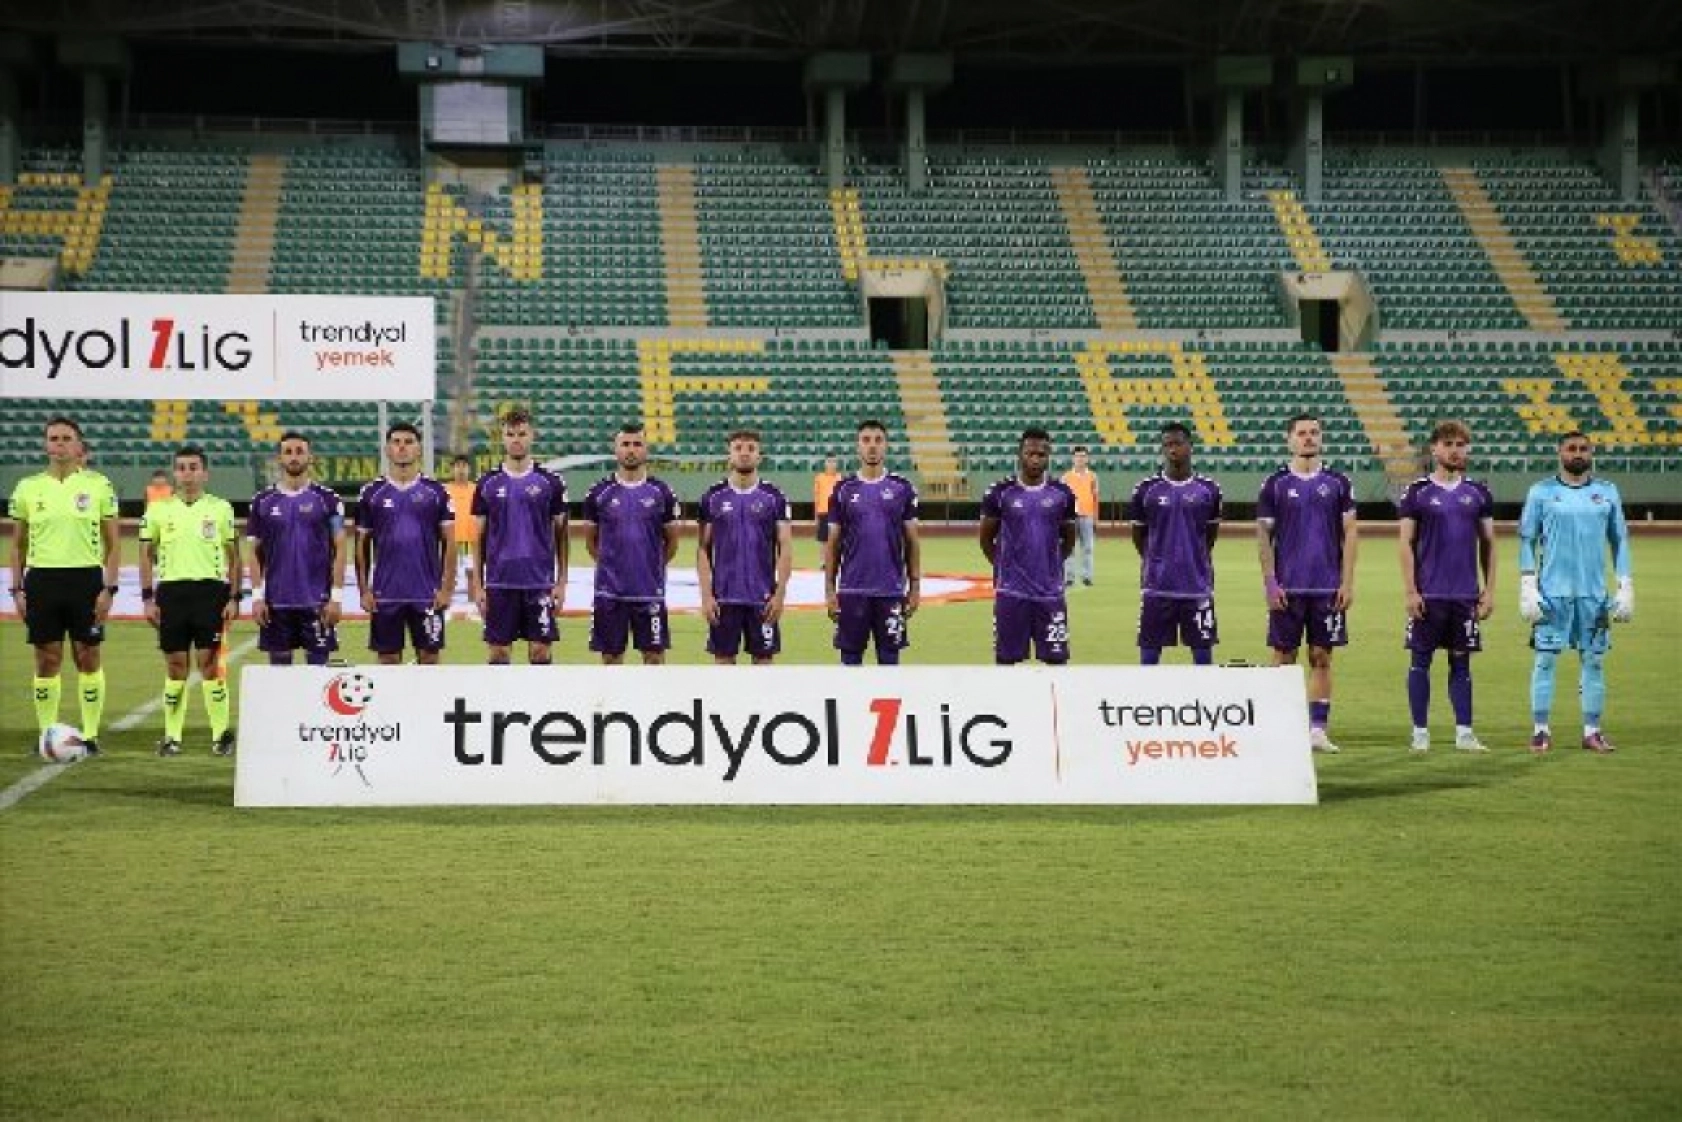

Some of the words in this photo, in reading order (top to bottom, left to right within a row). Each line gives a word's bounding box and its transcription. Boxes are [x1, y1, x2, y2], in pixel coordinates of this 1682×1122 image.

[300, 320, 406, 347] trendyol
[315, 349, 395, 371] yemek
[1099, 698, 1255, 731] trendyol
[299, 721, 401, 744] trendyol
[444, 697, 839, 781] trendyol
[1126, 736, 1239, 765] yemek
